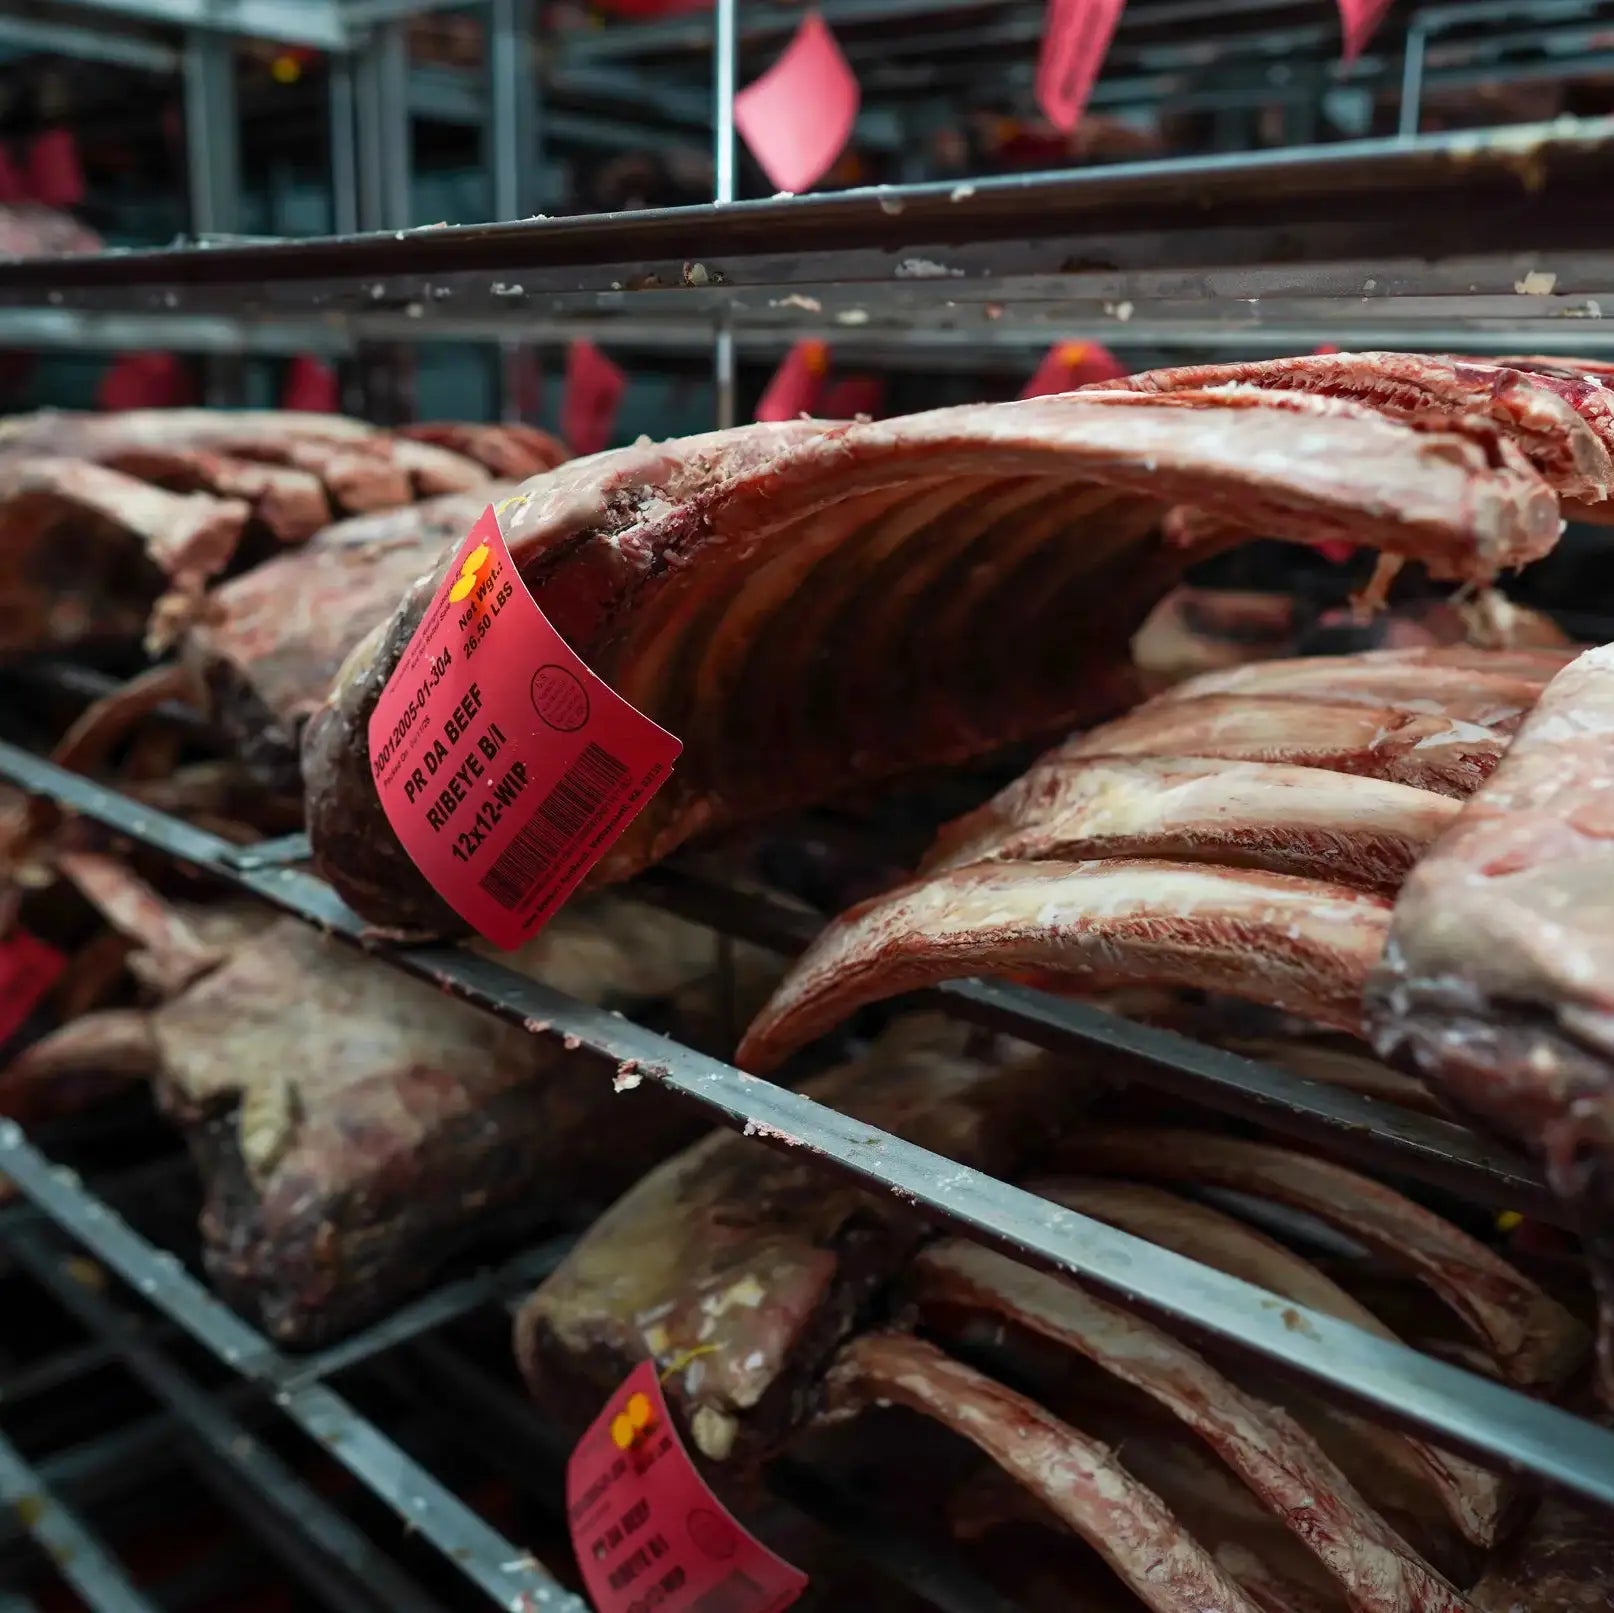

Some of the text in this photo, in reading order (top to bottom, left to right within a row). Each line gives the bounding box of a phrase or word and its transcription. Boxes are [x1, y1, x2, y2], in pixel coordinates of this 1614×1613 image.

[458, 603, 479, 631] Net
[463, 580, 513, 660] 26.50 LBS
[403, 682, 483, 804] PR DA BEEF
[425, 722, 507, 833] RIBEYE B/I
[452, 761, 530, 863] 12x12-WIP
